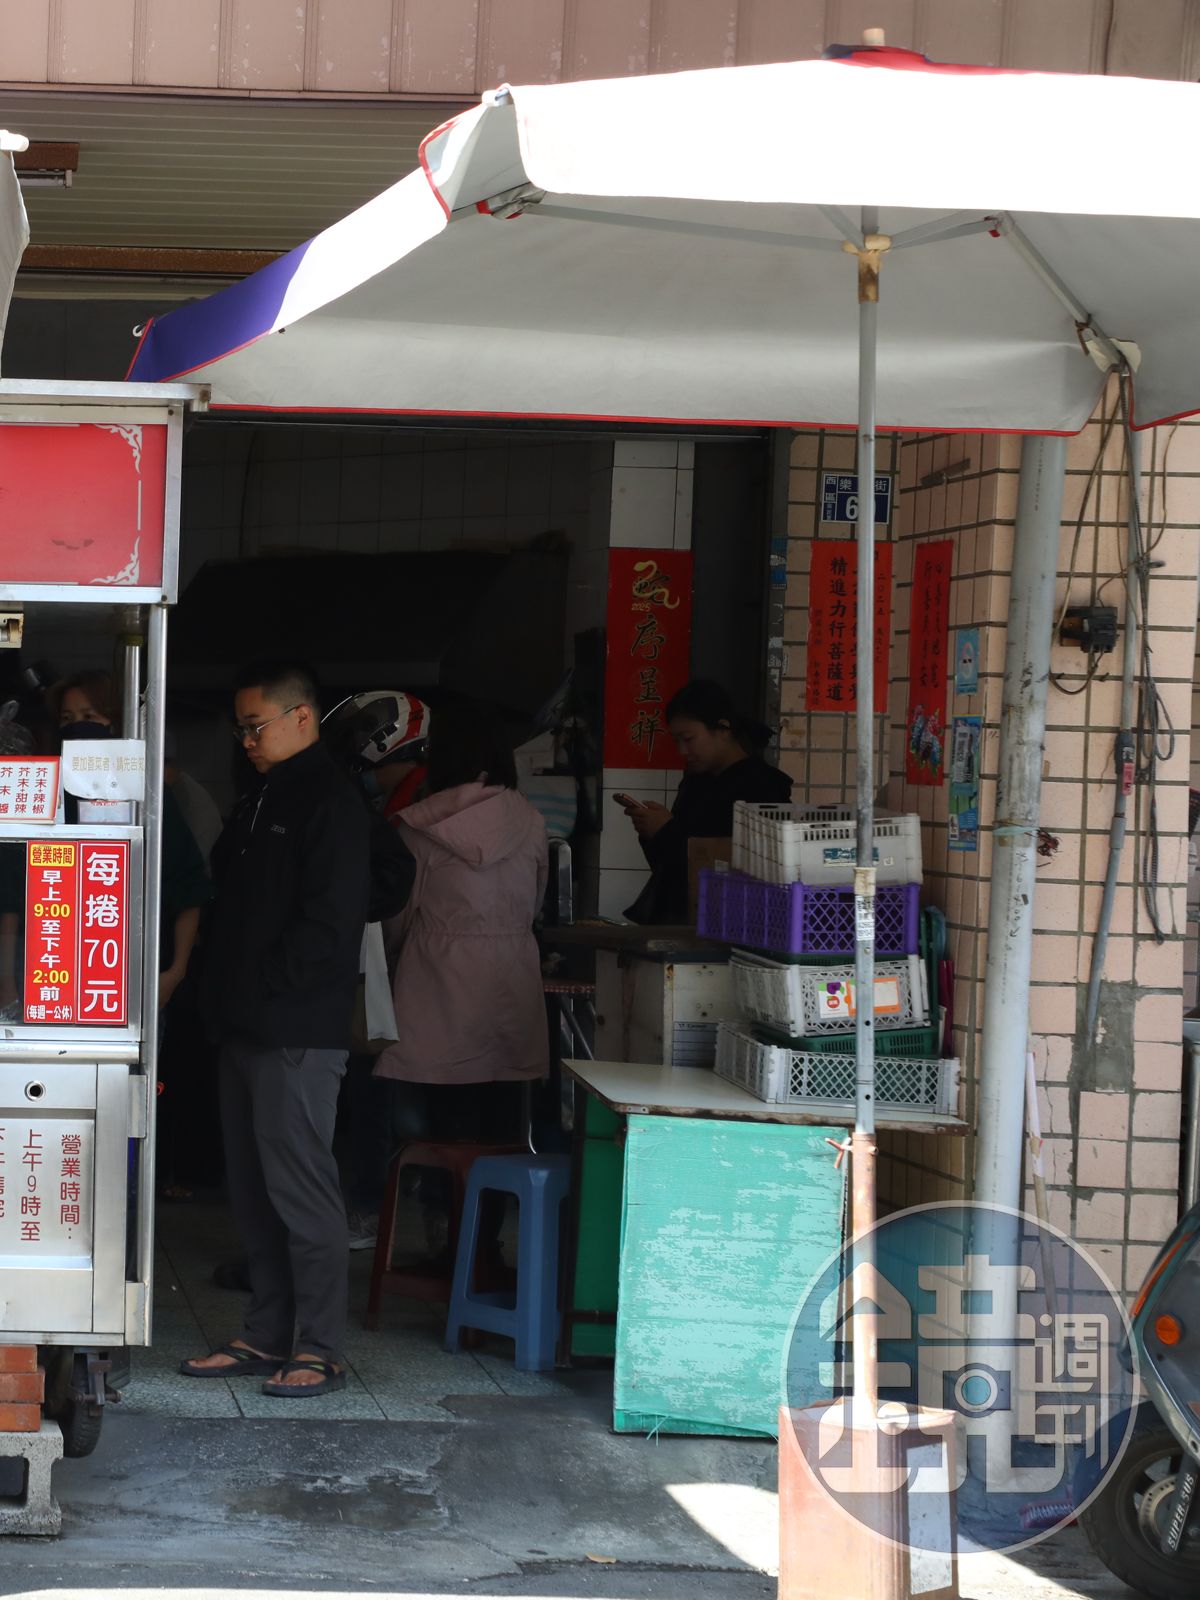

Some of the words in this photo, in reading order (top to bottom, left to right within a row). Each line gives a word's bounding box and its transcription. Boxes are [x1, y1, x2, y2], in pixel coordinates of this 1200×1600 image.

[840, 479, 887, 492] 樂街
[846, 496, 876, 519] 6
[32, 846, 72, 865] 營業時間
